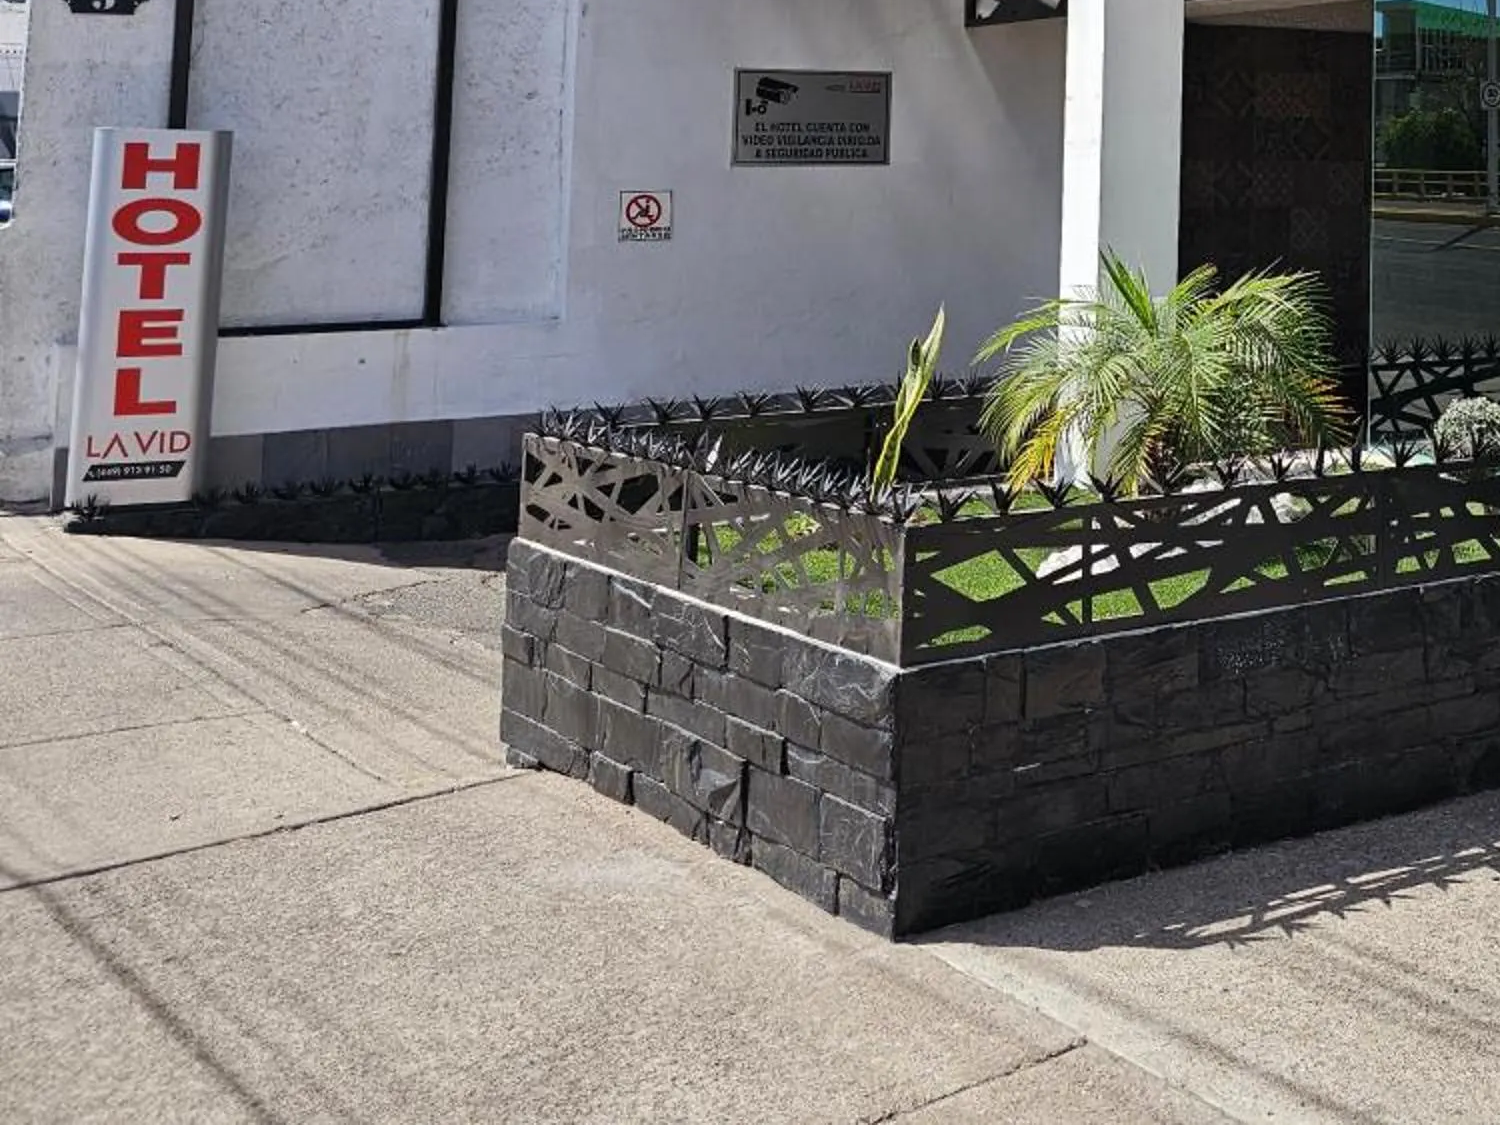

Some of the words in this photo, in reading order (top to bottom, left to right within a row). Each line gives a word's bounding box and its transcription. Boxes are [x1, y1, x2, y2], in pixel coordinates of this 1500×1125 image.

[770, 122, 802, 132] HOTEL
[806, 122, 846, 132] CUENTA
[849, 122, 870, 132] CON
[742, 134, 774, 145] VIDEO
[765, 148, 822, 159] SEGURIDAD
[112, 142, 202, 416] HOTEL
